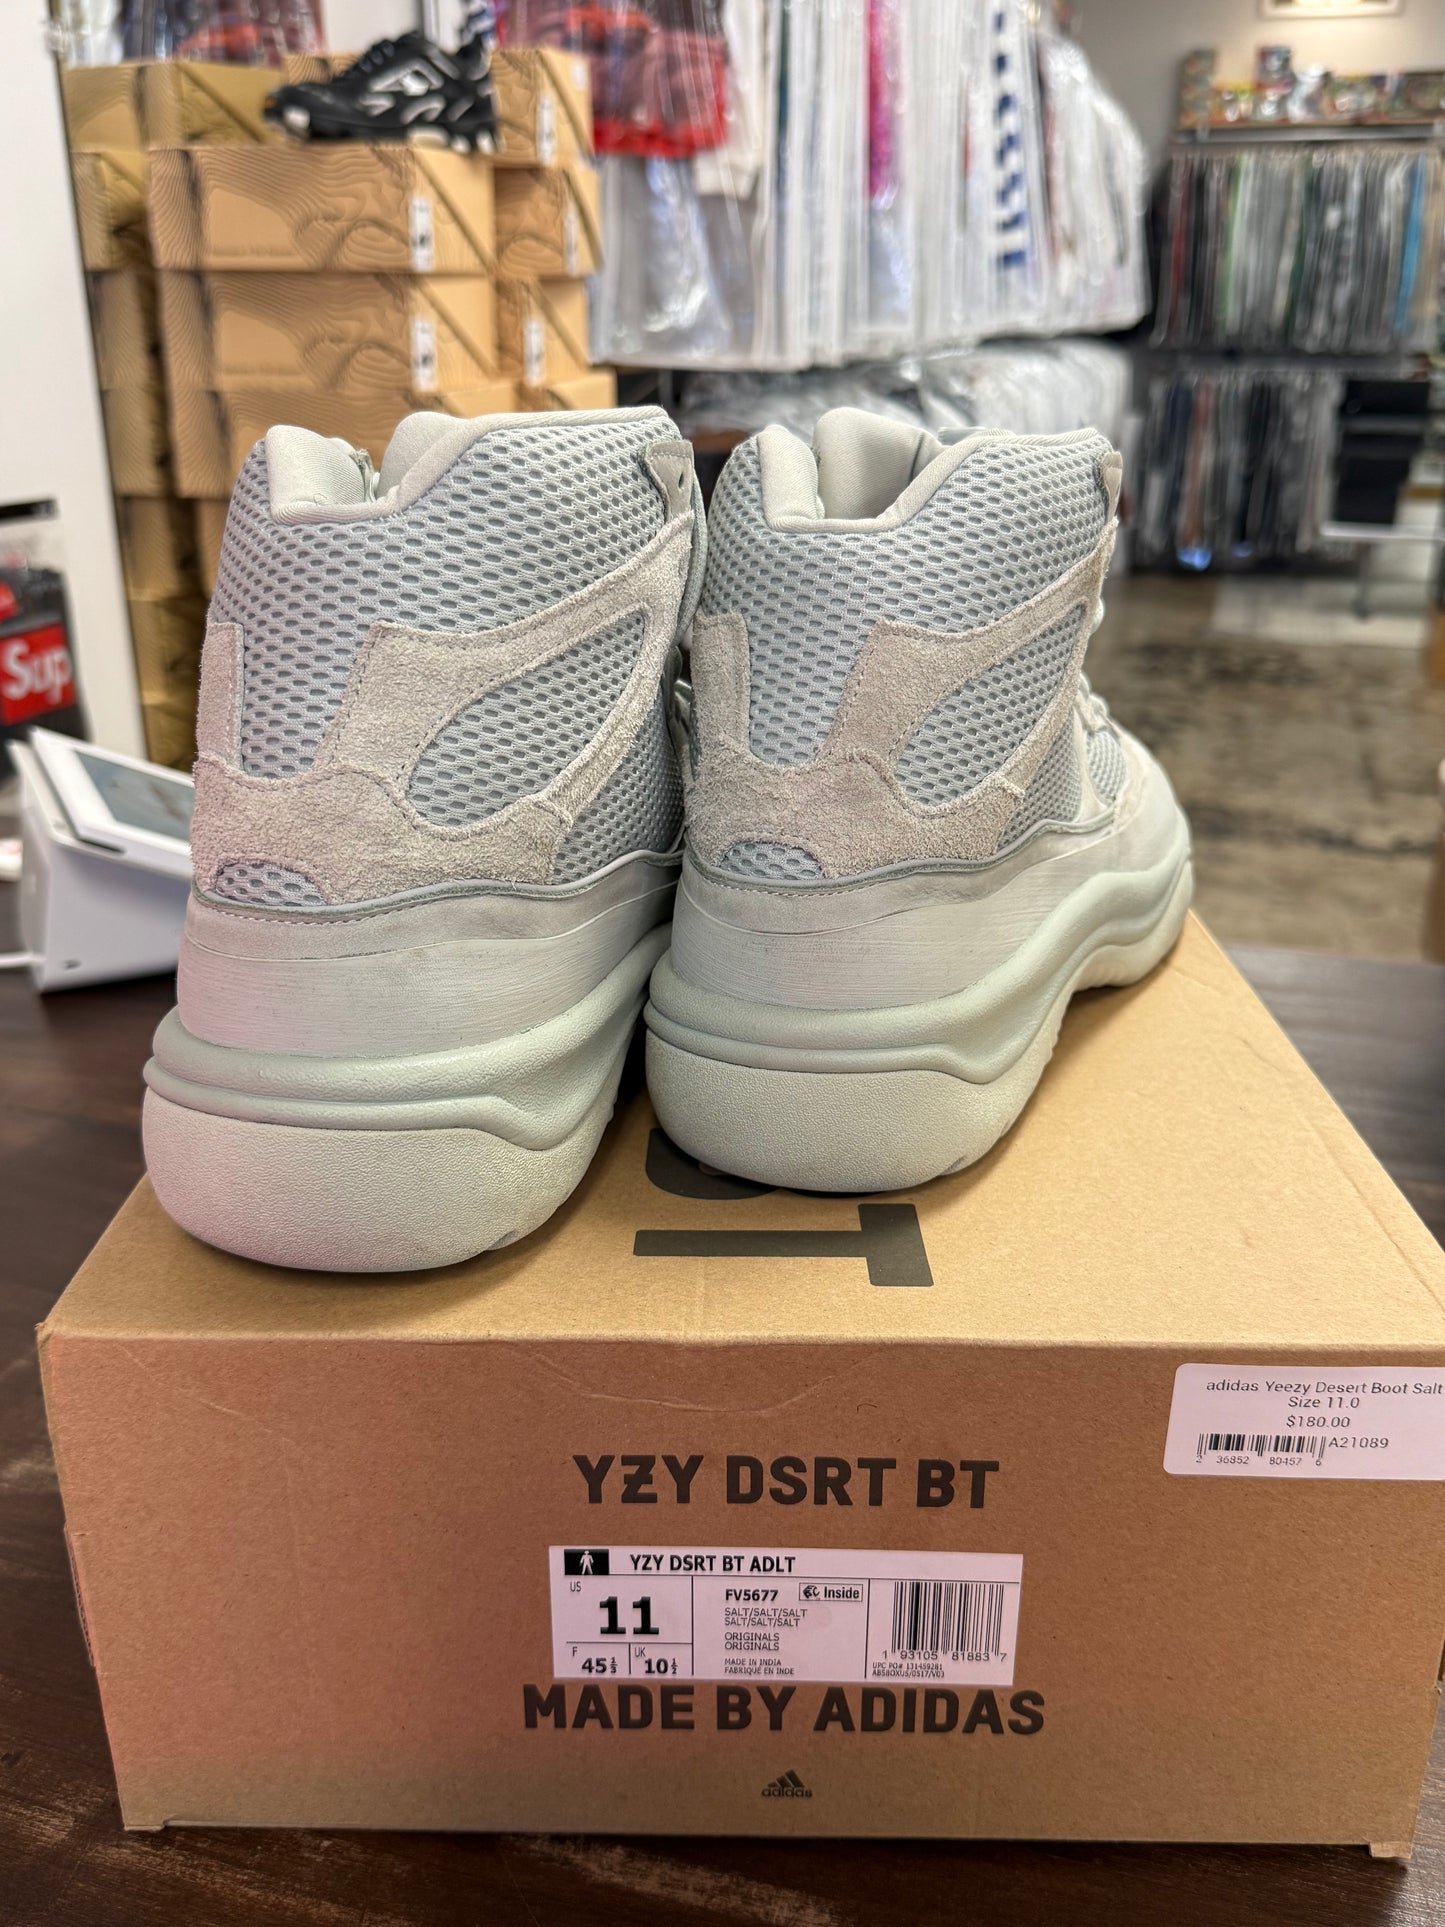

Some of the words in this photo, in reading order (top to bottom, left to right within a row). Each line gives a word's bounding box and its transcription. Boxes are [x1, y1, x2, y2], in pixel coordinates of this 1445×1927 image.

[1206, 1379, 1259, 1392] adidas
[1265, 1381, 1311, 1395] Yeezy
[1315, 1381, 1367, 1394] Desert
[1371, 1382, 1408, 1395] Boot
[1412, 1382, 1443, 1395] Salt
[1287, 1396, 1321, 1408] Size
[1327, 1396, 1360, 1408] 11.0
[1286, 1414, 1351, 1428] $180.00
[1328, 1437, 1390, 1449] A21089
[1216, 1455, 1250, 1465] 36852
[1269, 1457, 1303, 1466] 80457
[1315, 1458, 1322, 1467] 6
[726, 1455, 897, 1507] DSRT
[916, 1458, 1000, 1509] BT
[630, 1554, 664, 1571] YZY
[669, 1554, 717, 1572] DSRT
[722, 1555, 745, 1572] BT
[749, 1555, 796, 1573] ADLT
[569, 1581, 582, 1593] US
[824, 1586, 860, 1599] Inside
[725, 1589, 779, 1602] FV5677
[599, 1596, 660, 1635] 11
[724, 1607, 808, 1619] SALT/SALT/SALT
[724, 1617, 801, 1628] SALT/SALT/SALT
[724, 1632, 780, 1642] ORIGINALS
[572, 1647, 578, 1657] F
[724, 1641, 780, 1651] ORIGINALS
[634, 1647, 646, 1658] UK
[900, 1651, 938, 1661] 93105
[951, 1652, 990, 1662] 81883
[1000, 1653, 1007, 1663] 7
[724, 1658, 746, 1667] MADE
[749, 1658, 757, 1667] IN
[760, 1658, 782, 1667] INDIA
[872, 1662, 887, 1670] UPC
[764, 1667, 774, 1676] EN
[776, 1667, 795, 1676] INDE
[523, 1684, 695, 1729] MADE
[716, 1686, 797, 1732] BY
[813, 1686, 1045, 1735] ADIDAS
[761, 1786, 813, 1798] adidas
